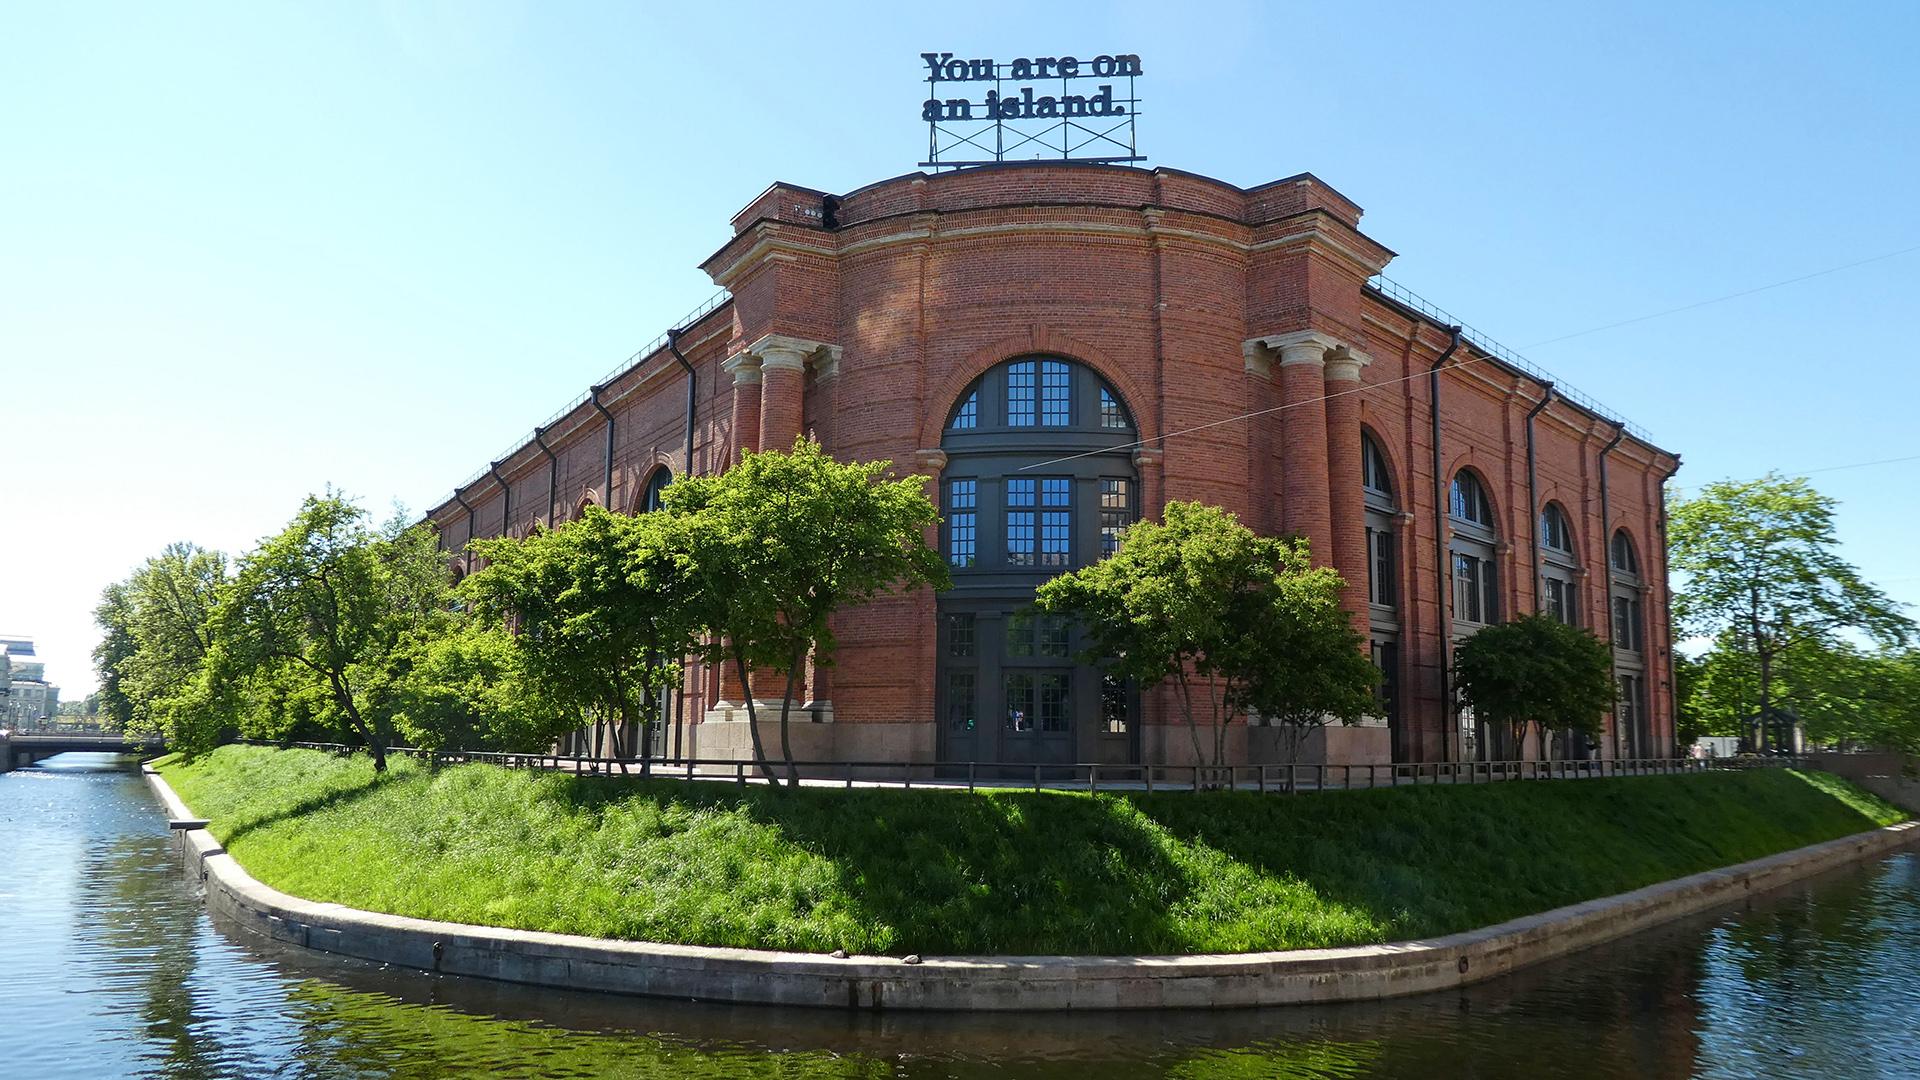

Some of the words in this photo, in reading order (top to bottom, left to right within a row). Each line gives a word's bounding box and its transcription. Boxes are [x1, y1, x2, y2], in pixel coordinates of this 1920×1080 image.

[921, 53, 996, 81] You
[1011, 56, 1079, 80] are
[1092, 53, 1143, 78] on
[922, 98, 972, 121] an
[985, 85, 1125, 119] island.
